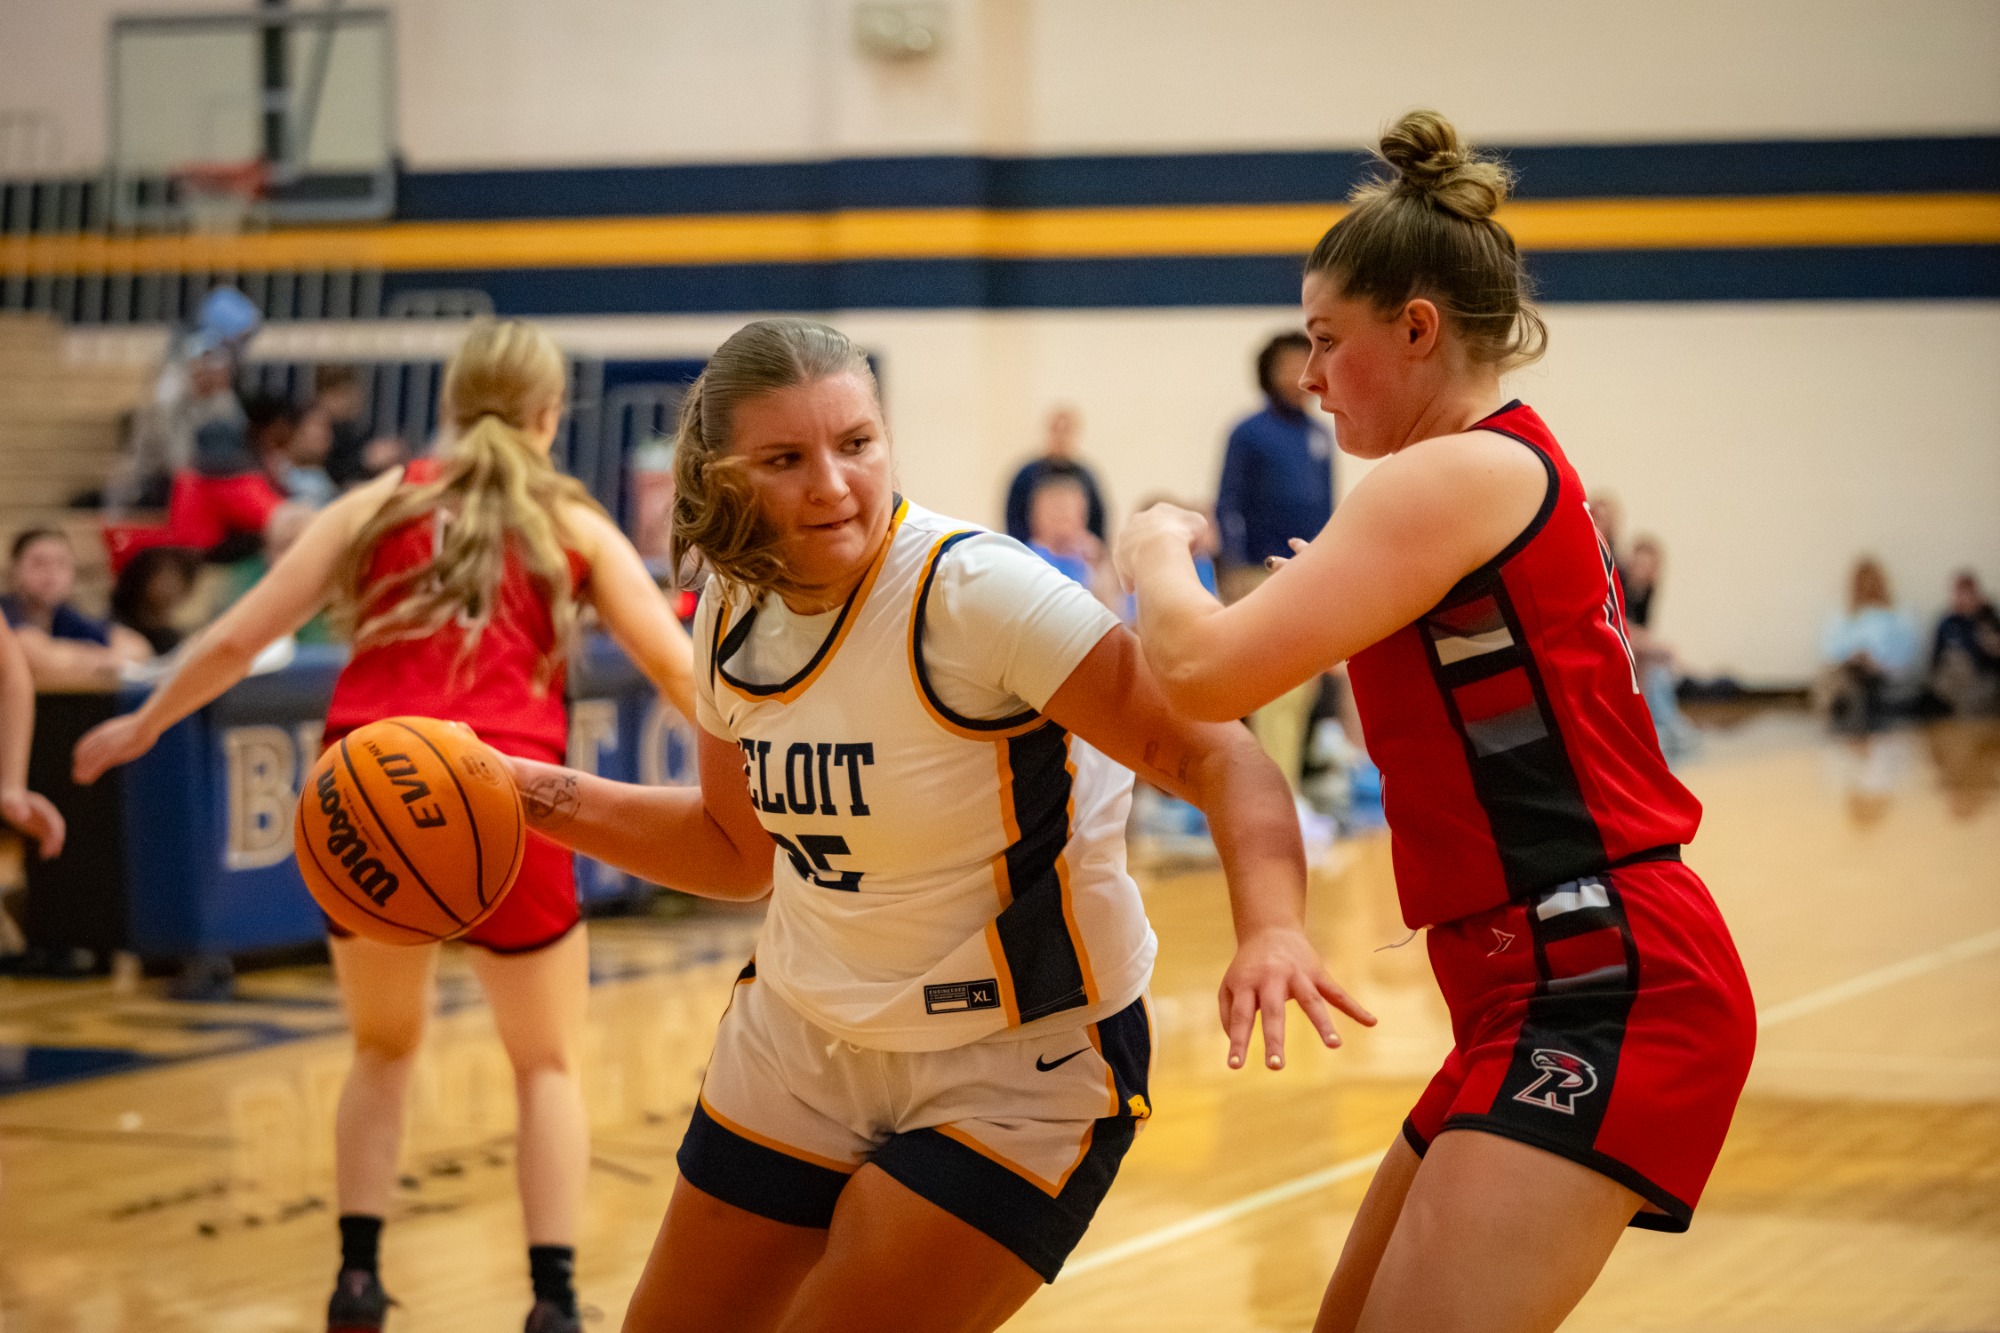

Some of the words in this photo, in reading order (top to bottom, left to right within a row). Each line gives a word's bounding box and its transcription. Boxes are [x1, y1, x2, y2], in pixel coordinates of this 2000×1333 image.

[377, 753, 447, 828] EVO
[317, 765, 399, 908] Wilson
[972, 990, 992, 1003] XL
